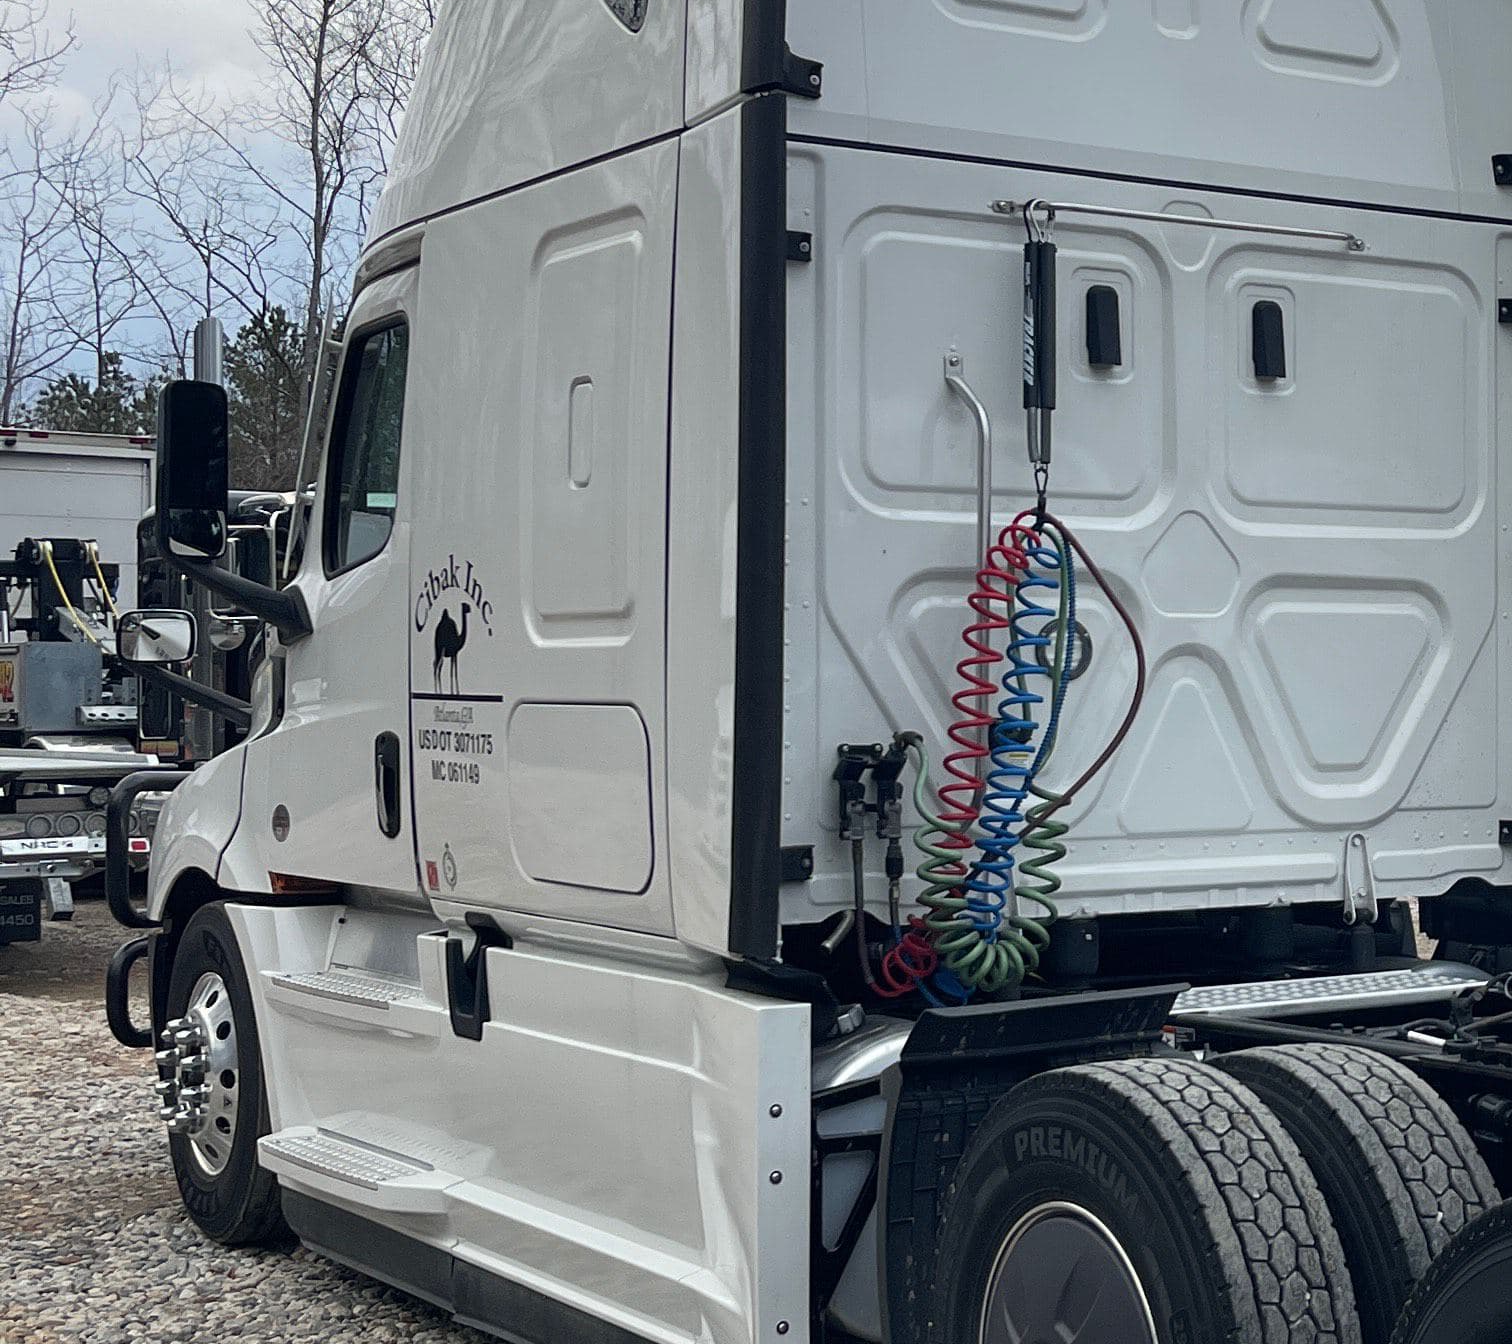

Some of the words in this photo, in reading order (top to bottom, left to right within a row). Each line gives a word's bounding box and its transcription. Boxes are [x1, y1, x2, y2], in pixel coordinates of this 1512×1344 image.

[415, 554, 460, 633] Cibak
[464, 560, 493, 636] Inc.
[419, 729, 451, 752] USDOT
[1014, 1126, 1138, 1215] PREMIUM
